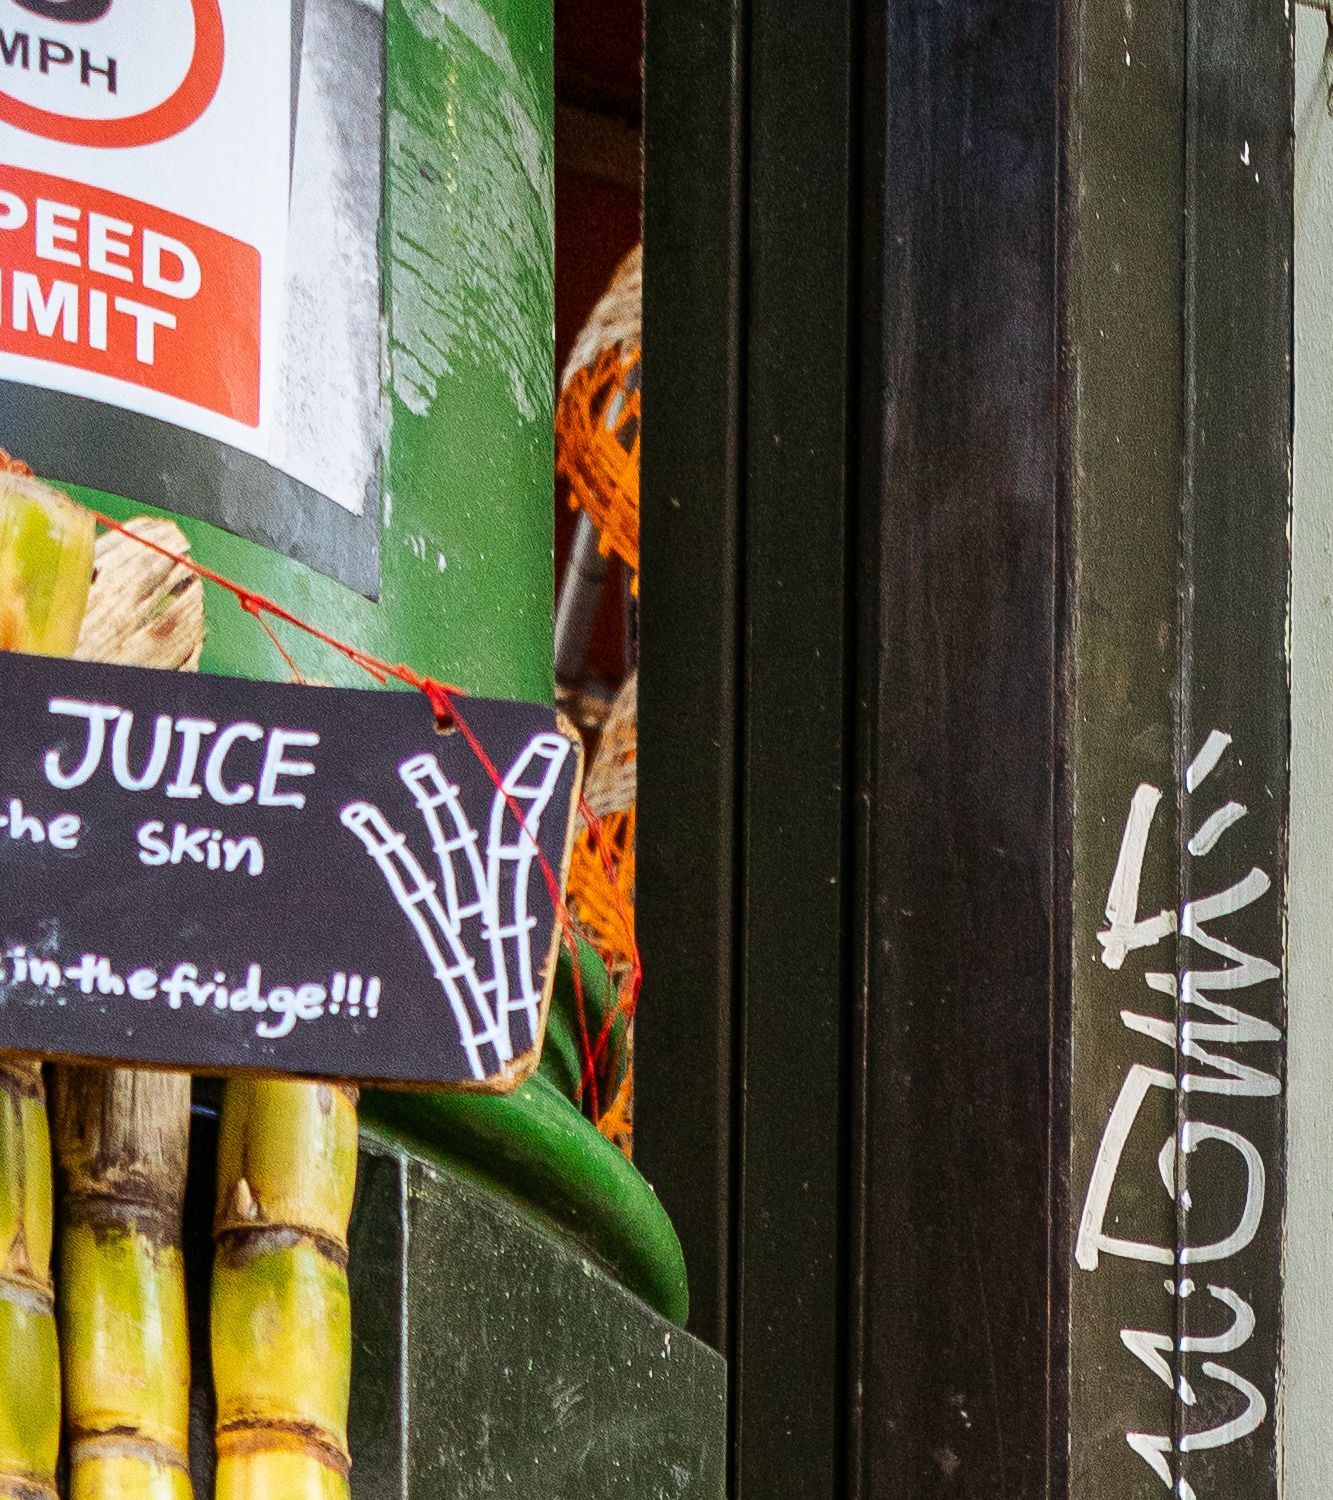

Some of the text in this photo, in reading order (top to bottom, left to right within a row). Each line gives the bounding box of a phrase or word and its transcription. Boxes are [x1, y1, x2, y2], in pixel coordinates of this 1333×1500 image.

[0, 28, 118, 95] MPH
[0, 269, 178, 367] MIT
[44, 698, 321, 810] JUICE
